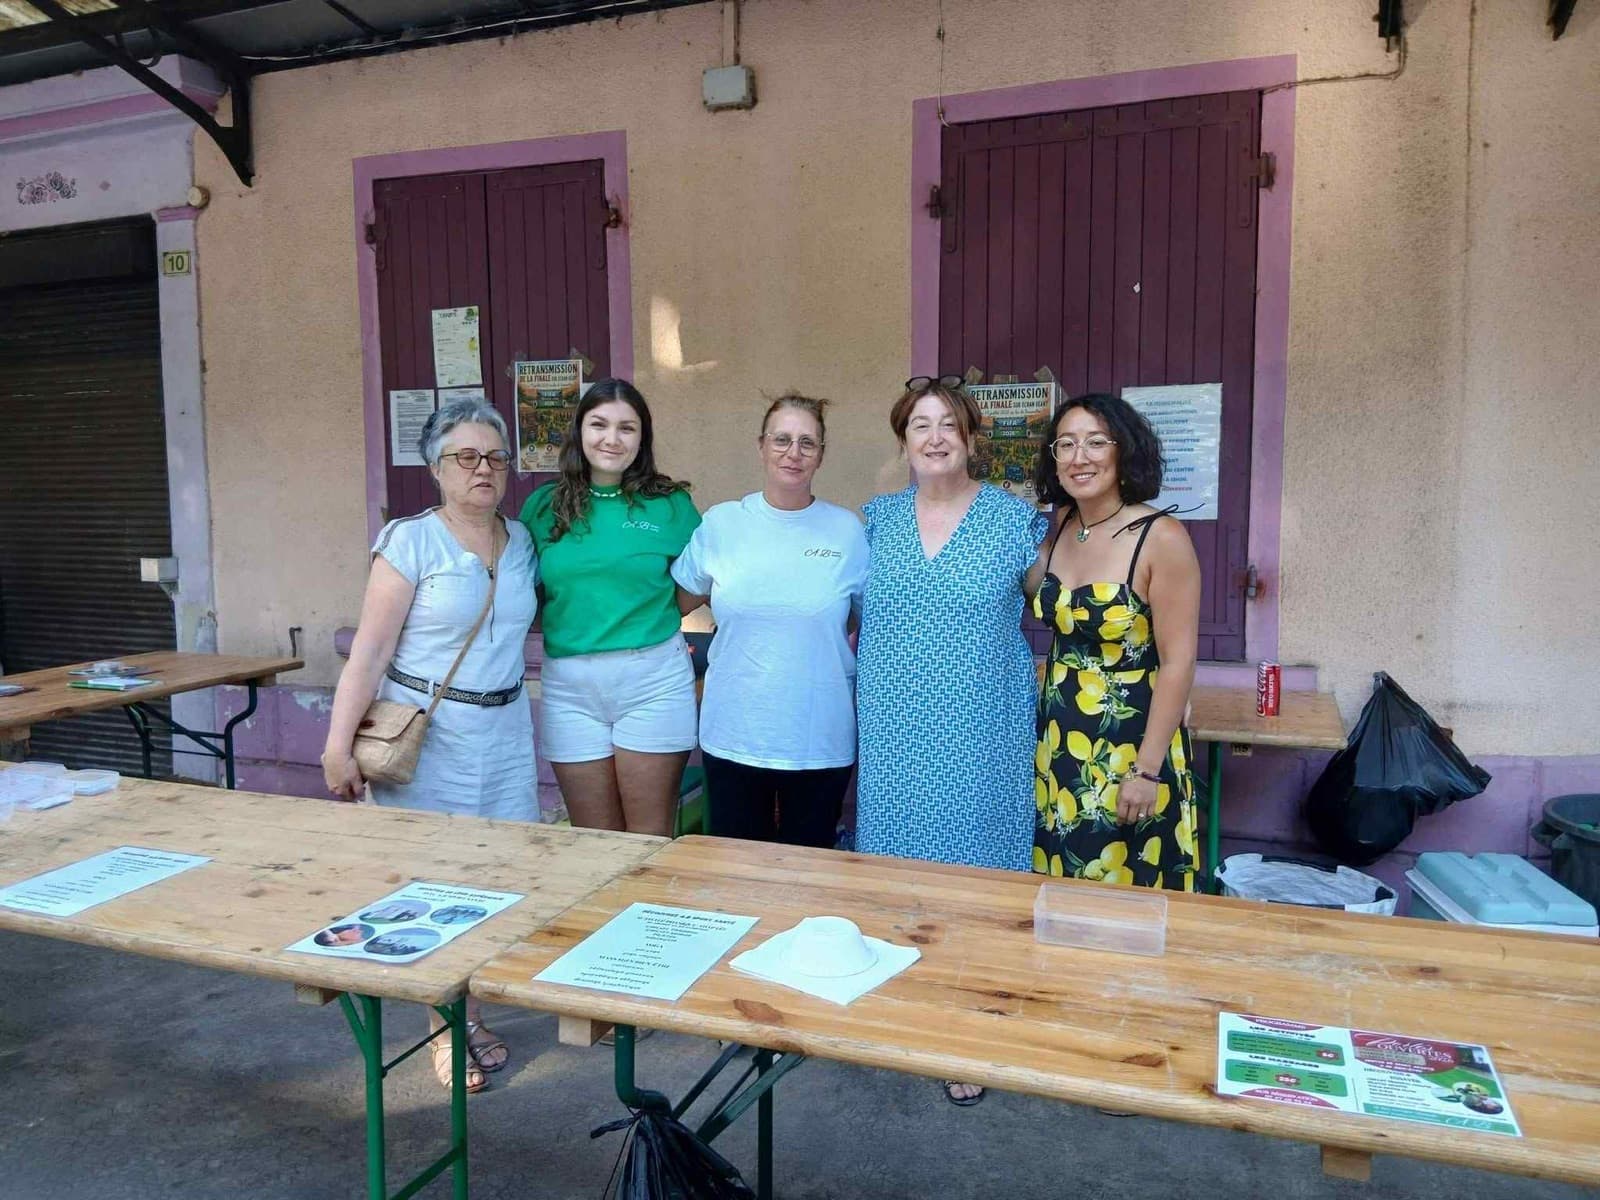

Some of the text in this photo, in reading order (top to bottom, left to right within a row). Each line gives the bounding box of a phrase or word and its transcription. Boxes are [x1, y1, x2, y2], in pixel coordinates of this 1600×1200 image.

[168, 254, 185, 271] 10
[520, 363, 578, 375] RETRANSMISSION
[534, 374, 551, 382] FINALE
[971, 387, 1048, 401] RETRANSMISSION
[981, 401, 989, 409] LA
[990, 400, 1012, 409] FINALE
